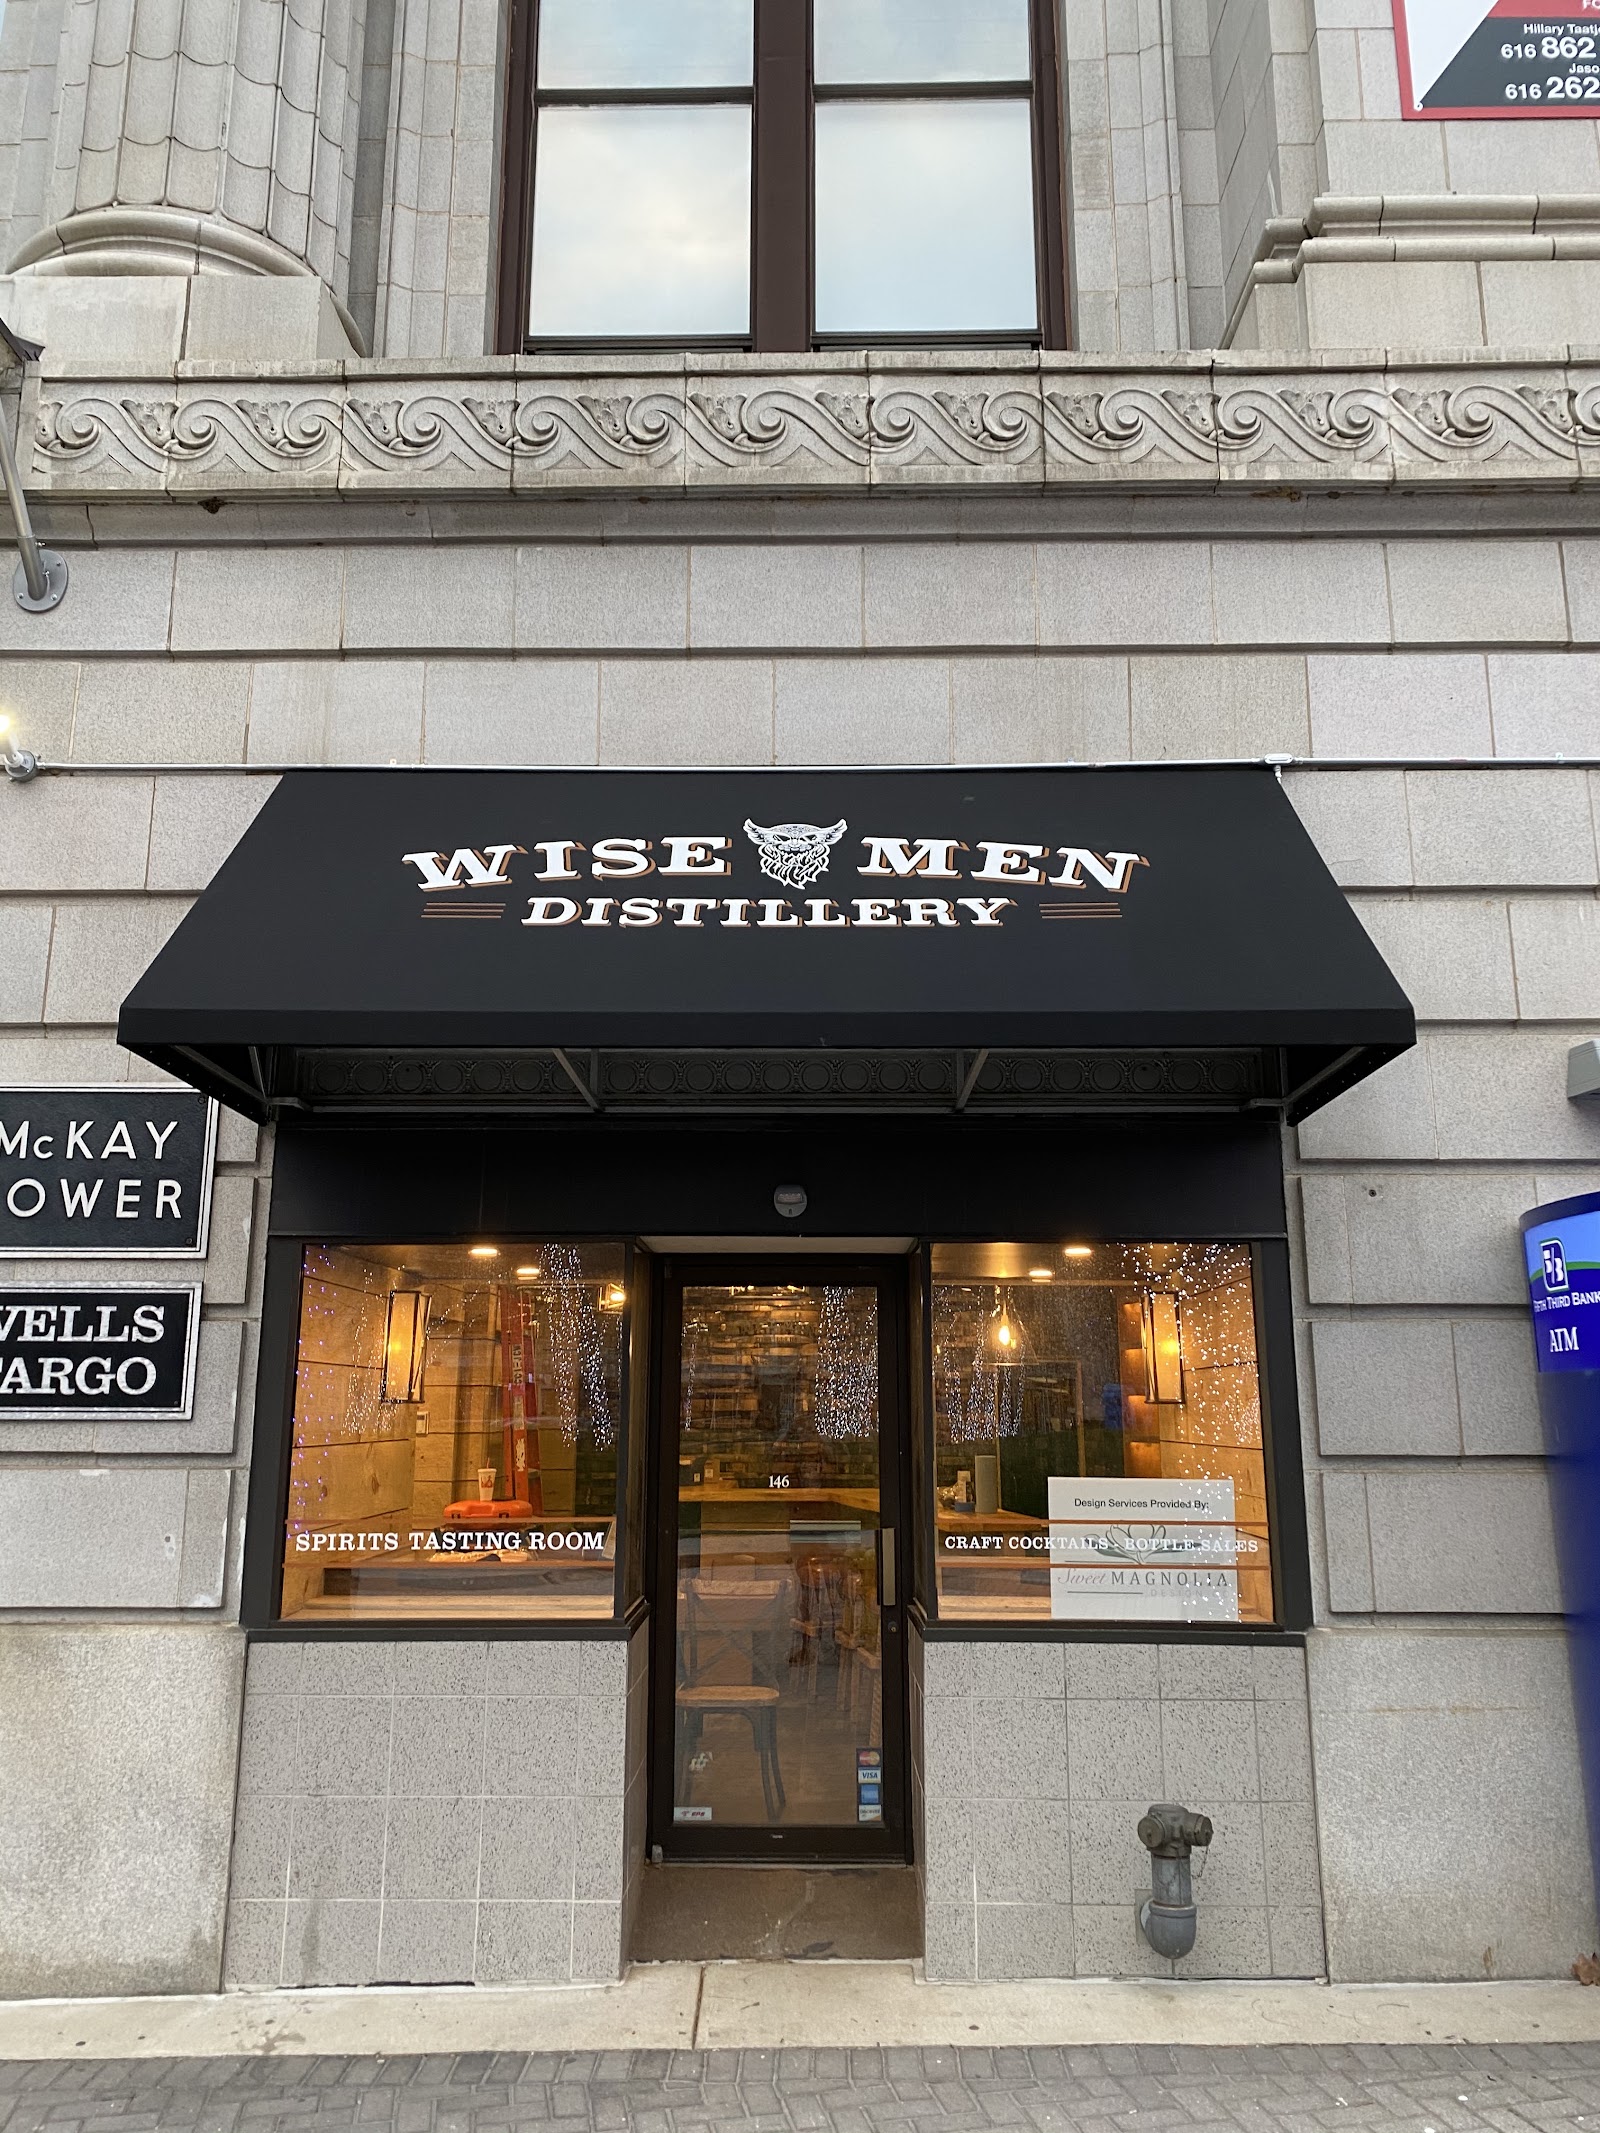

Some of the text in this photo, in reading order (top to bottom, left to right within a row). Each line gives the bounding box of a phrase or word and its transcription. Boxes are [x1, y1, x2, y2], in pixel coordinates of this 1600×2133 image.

[1523, 23, 1564, 36] Hillary
[1500, 36, 1597, 59] 616 862
[1505, 76, 1600, 100] 616 262
[401, 836, 1151, 893] WISE MEN
[520, 896, 1018, 928] DISTILLERY
[1549, 1326, 1580, 1353] ATM
[0, 1355, 157, 1396] ARGO
[769, 1474, 790, 1489] 146
[1074, 1498, 1209, 1510] Design Services Provided By:
[295, 1531, 605, 1552] SPIRITS TASTING ROOM
[944, 1535, 1003, 1550] CRAFT
[1008, 1536, 1109, 1550] COCKTAILS
[1124, 1538, 1194, 1551] BOTTLE
[1200, 1540, 1259, 1552] SALES
[1057, 1568, 1229, 1587] Sweet MAGNOLIA
[862, 1771, 878, 1779] VISA
